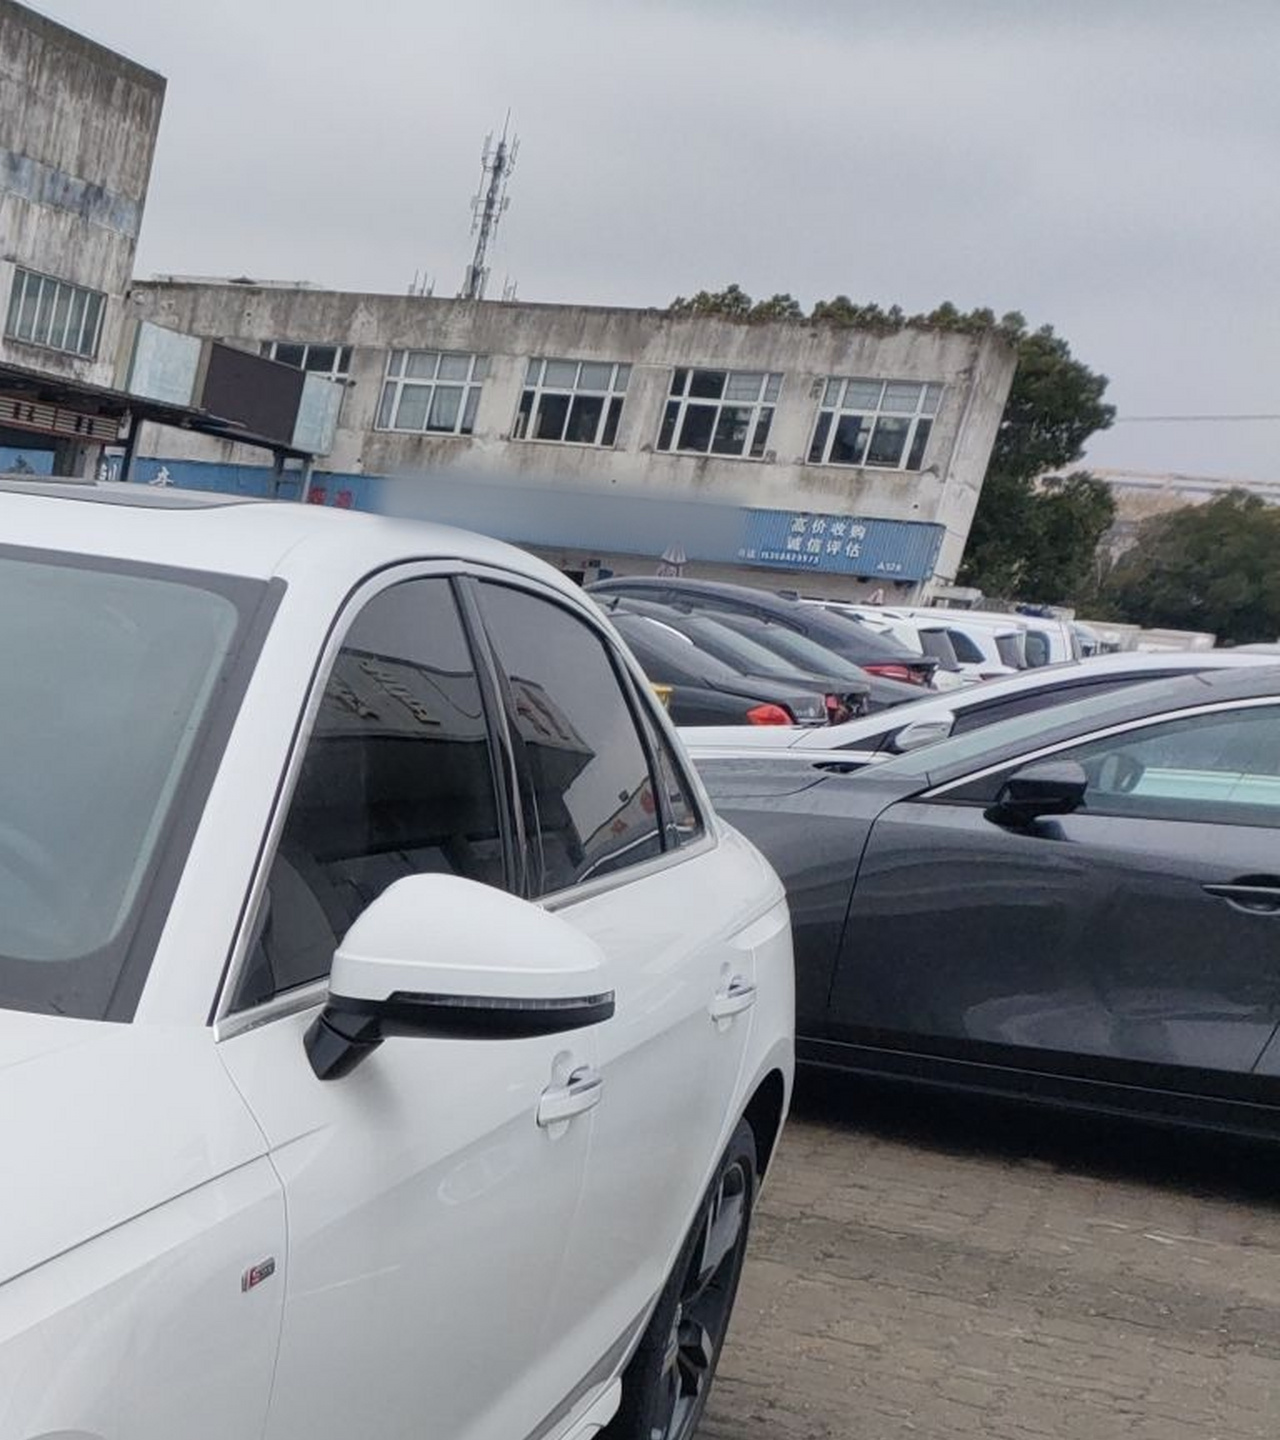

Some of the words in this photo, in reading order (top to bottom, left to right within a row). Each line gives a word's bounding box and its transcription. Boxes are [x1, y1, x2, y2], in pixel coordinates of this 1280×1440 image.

[790, 516, 867, 541] 高价收购
[786, 536, 861, 559] 诚信评估
